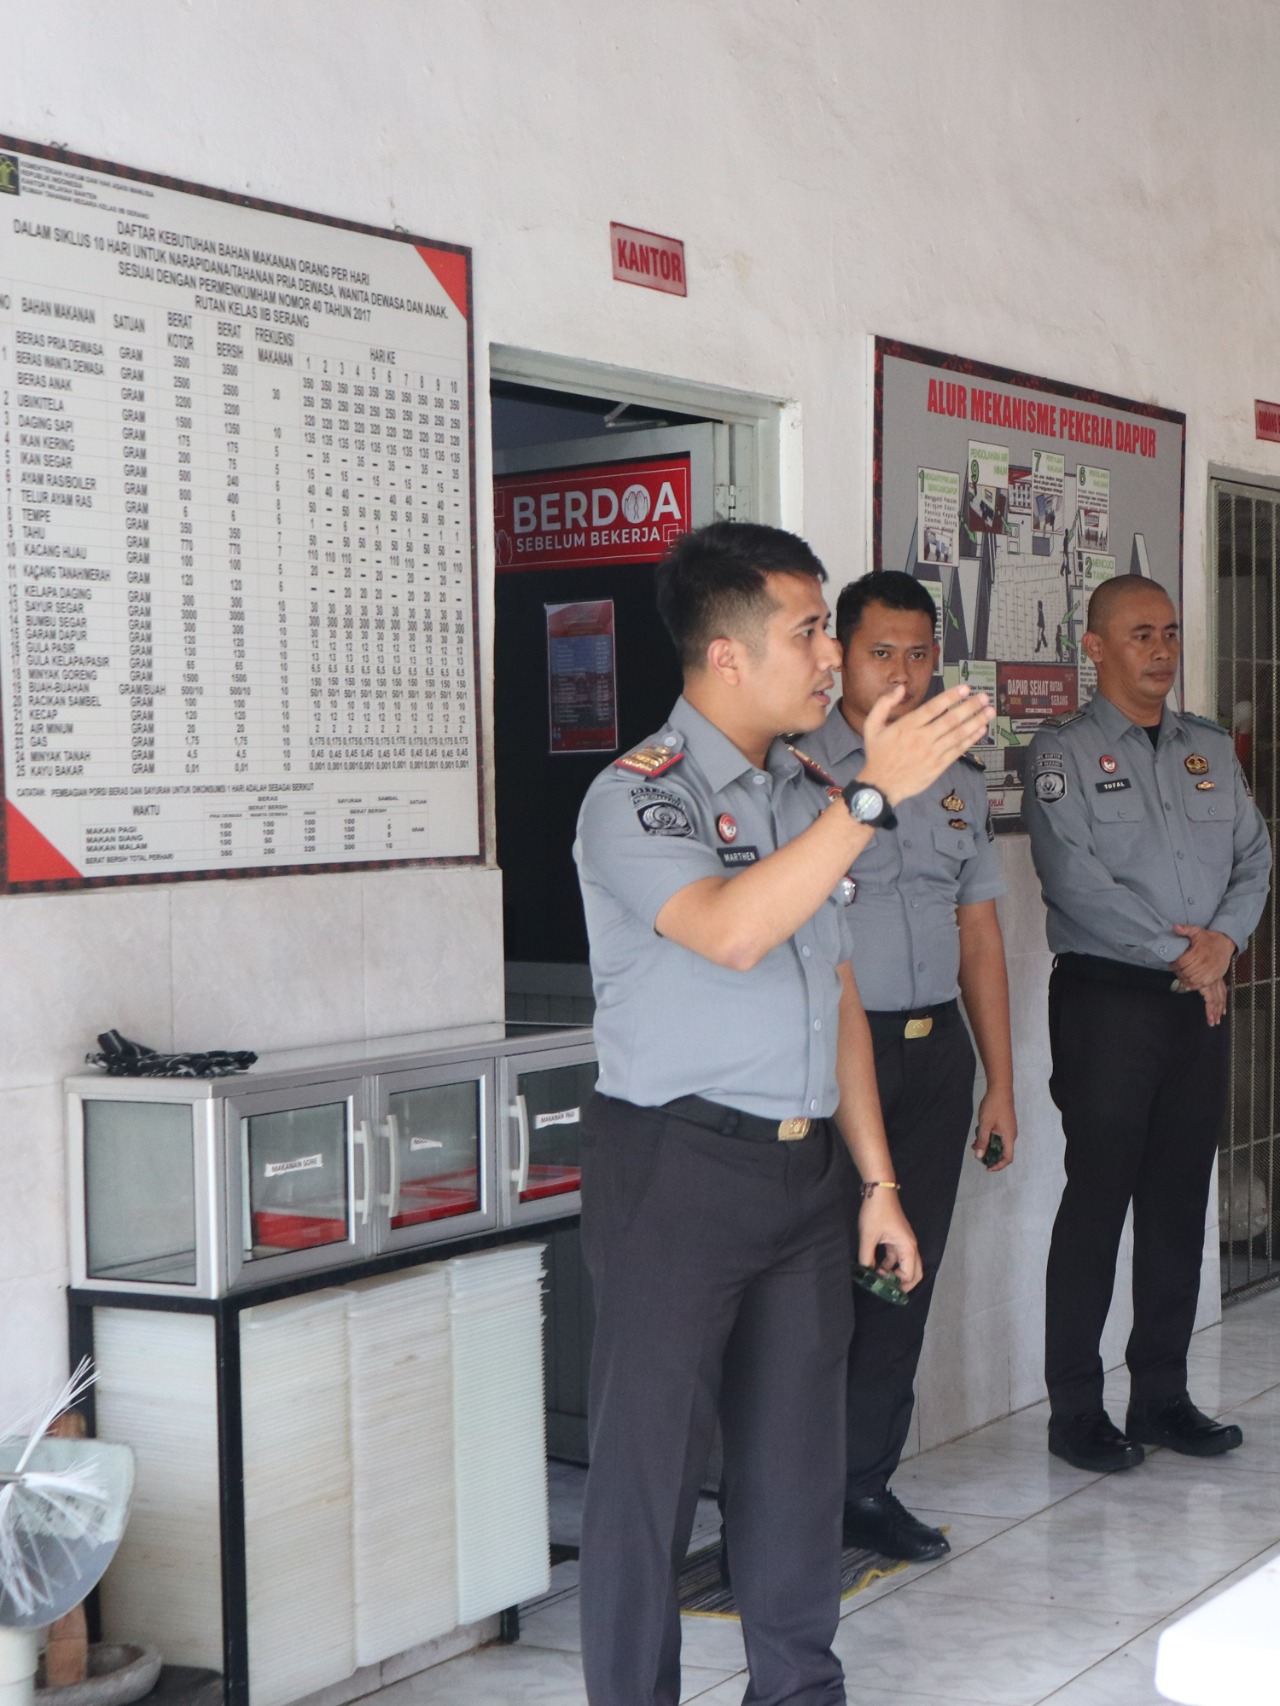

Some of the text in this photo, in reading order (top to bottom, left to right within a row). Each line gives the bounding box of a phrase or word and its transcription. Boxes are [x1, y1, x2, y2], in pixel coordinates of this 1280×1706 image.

[117, 220, 370, 287] DAFTAR KEBUTUHAN BAHAN MAKANAN ORANG PER HARI
[617, 238, 682, 284] KANTOR
[13, 218, 51, 240] DALAM
[54, 227, 91, 248] SIKLUS
[94, 236, 105, 251] 10
[107, 239, 130, 256] HARI
[133, 244, 166, 264] UNTUK
[169, 252, 274, 284] NARAPIDANA/TAHANAN
[276, 274, 296, 290] PRIA
[338, 286, 370, 304] WANITA
[372, 291, 405, 312] DEWASA
[407, 299, 424, 314] DAN
[118, 260, 372, 323] SESUAI DENGAN PERMENKUMHAM NOMOR 40 TAHUN 2017
[21, 296, 51, 317] BAHAN
[113, 314, 146, 334] SATUAN
[167, 311, 193, 330] BERAT
[195, 294, 226, 313] RUTAN
[228, 301, 258, 320] KELAS
[273, 311, 310, 329] SERANG
[217, 320, 242, 340] BERAT
[255, 326, 295, 348] FREKUENSI
[16, 329, 45, 348] BERAS
[47, 335, 67, 350] PRIA
[119, 345, 144, 362] GRAM
[167, 333, 195, 351] KOTOR
[216, 341, 244, 360] BERSIH
[257, 347, 293, 368] MAKANAN
[369, 347, 396, 366] HARI KE
[927, 378, 1156, 459] ALUR MEKANISME PEKERJA DAPUR
[1033, 452, 1042, 472] 7
[513, 481, 682, 534] BERDOA
[517, 526, 661, 552] SEBELUM BEKERJA
[1085, 556, 1093, 578] 2
[1008, 679, 1029, 696] DAPUR
[1030, 680, 1050, 697] SEHAT
[724, 851, 756, 862] MARTHEN
